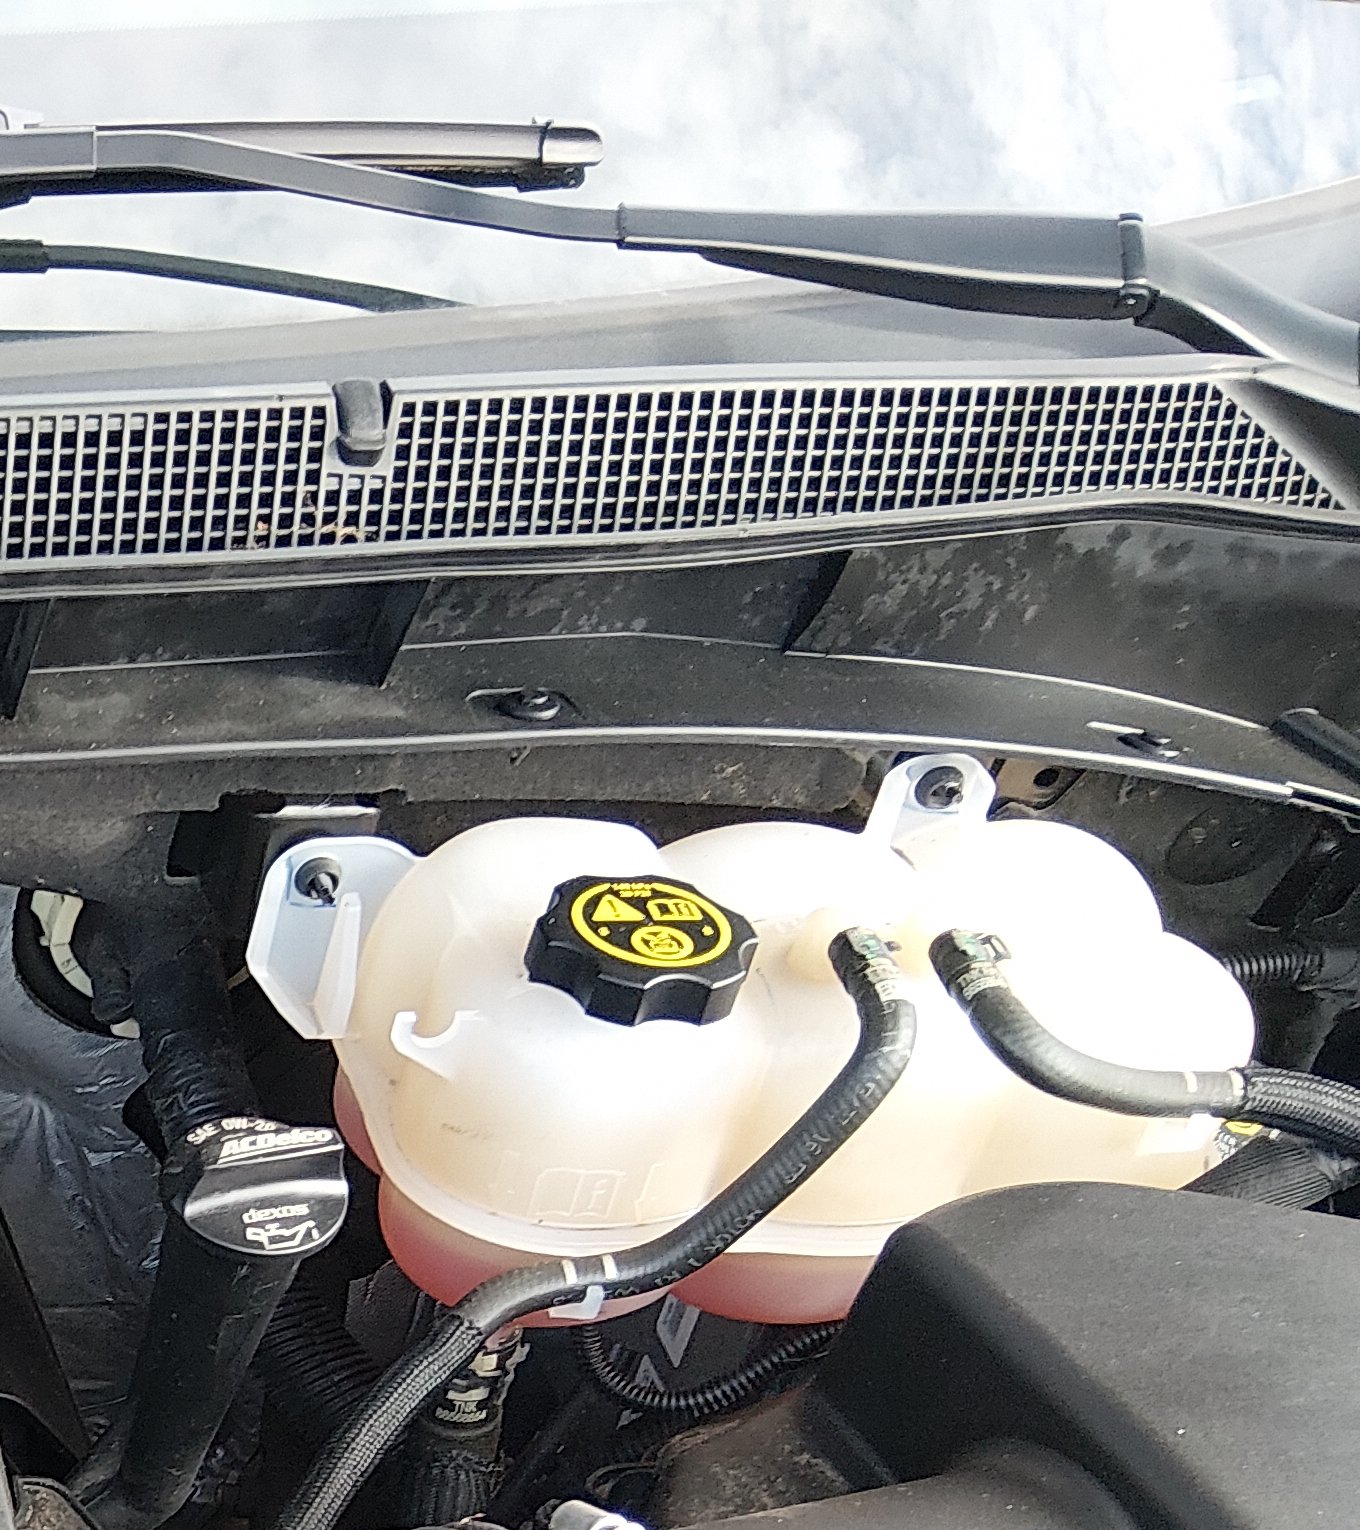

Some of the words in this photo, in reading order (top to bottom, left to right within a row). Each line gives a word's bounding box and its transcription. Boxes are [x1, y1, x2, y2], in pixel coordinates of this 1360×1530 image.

[186, 1123, 220, 1145] SAE
[219, 1129, 334, 1159] ACDelco
[241, 1203, 310, 1224] dexos
